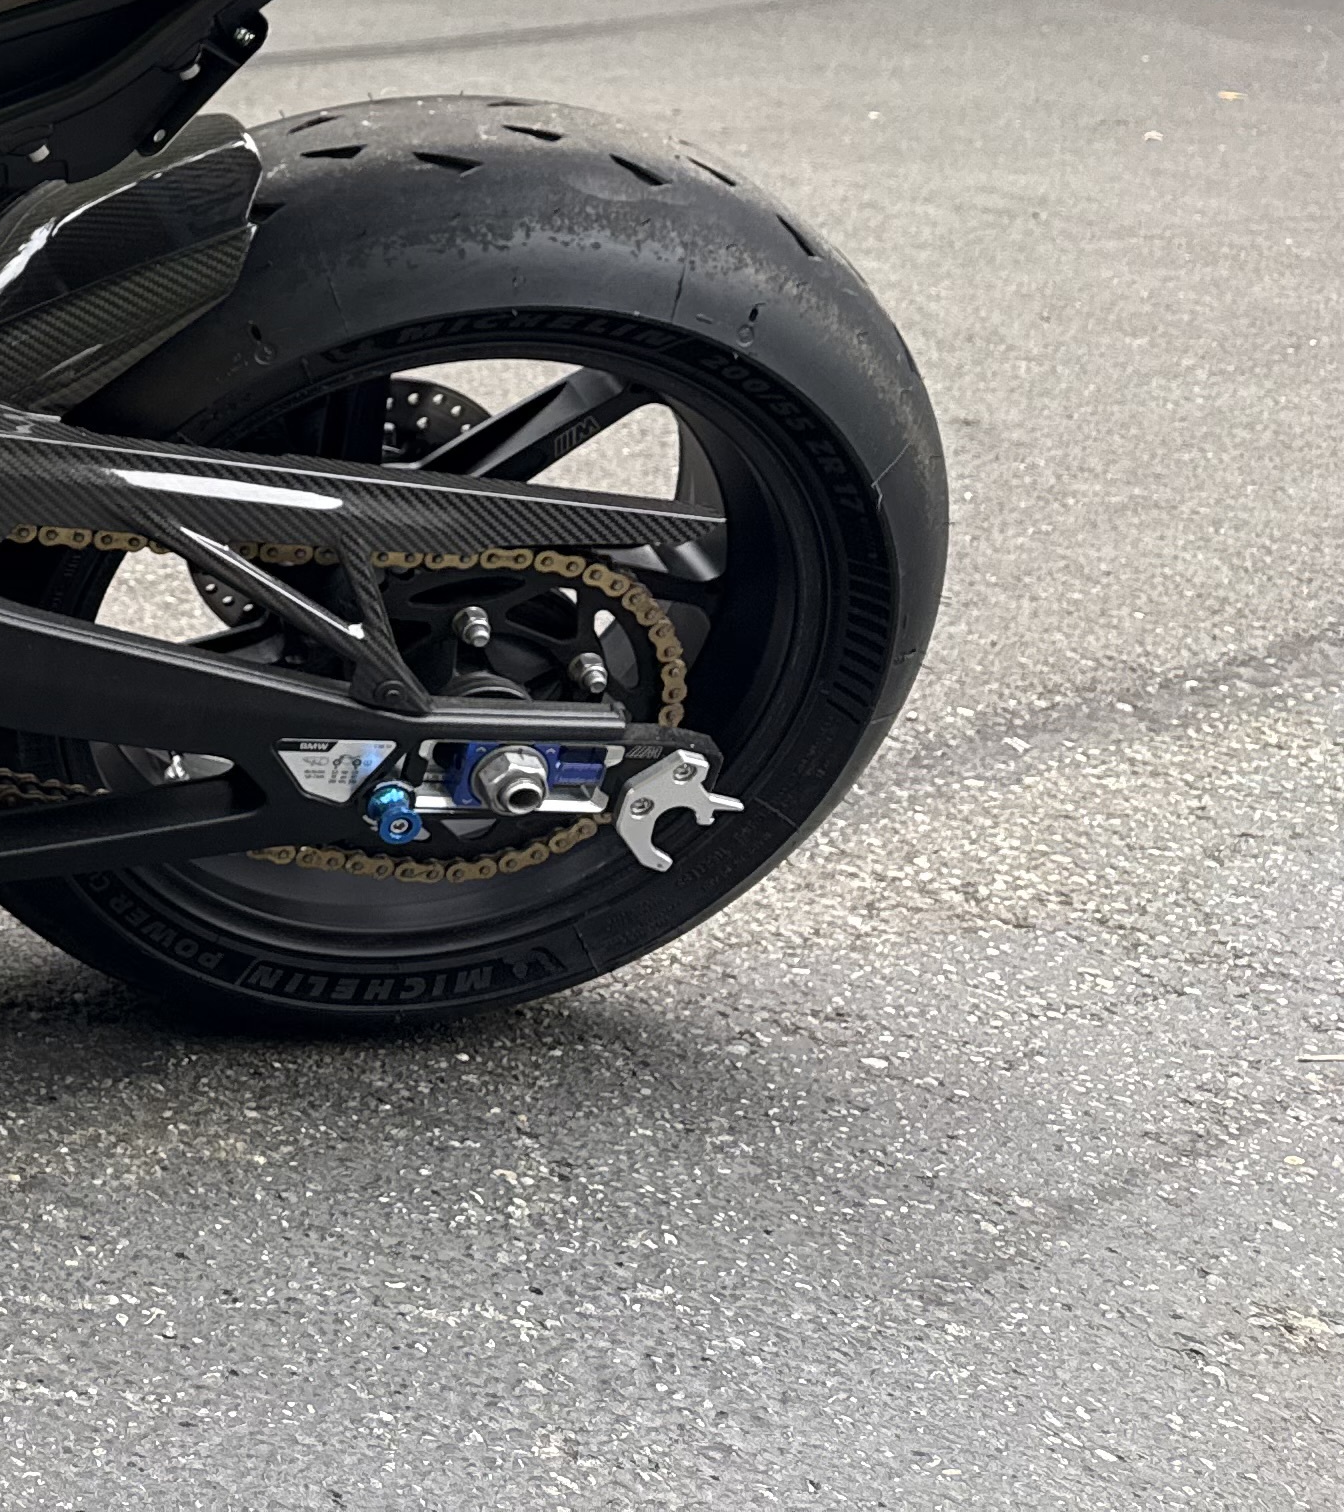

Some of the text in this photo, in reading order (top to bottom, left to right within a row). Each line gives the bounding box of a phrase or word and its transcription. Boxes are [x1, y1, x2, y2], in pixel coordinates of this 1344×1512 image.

[396, 314, 677, 349] MICHELIN
[698, 355, 816, 431] 200/55
[299, 742, 329, 751] BMW
[109, 893, 495, 1001] MICHELIN POWER
